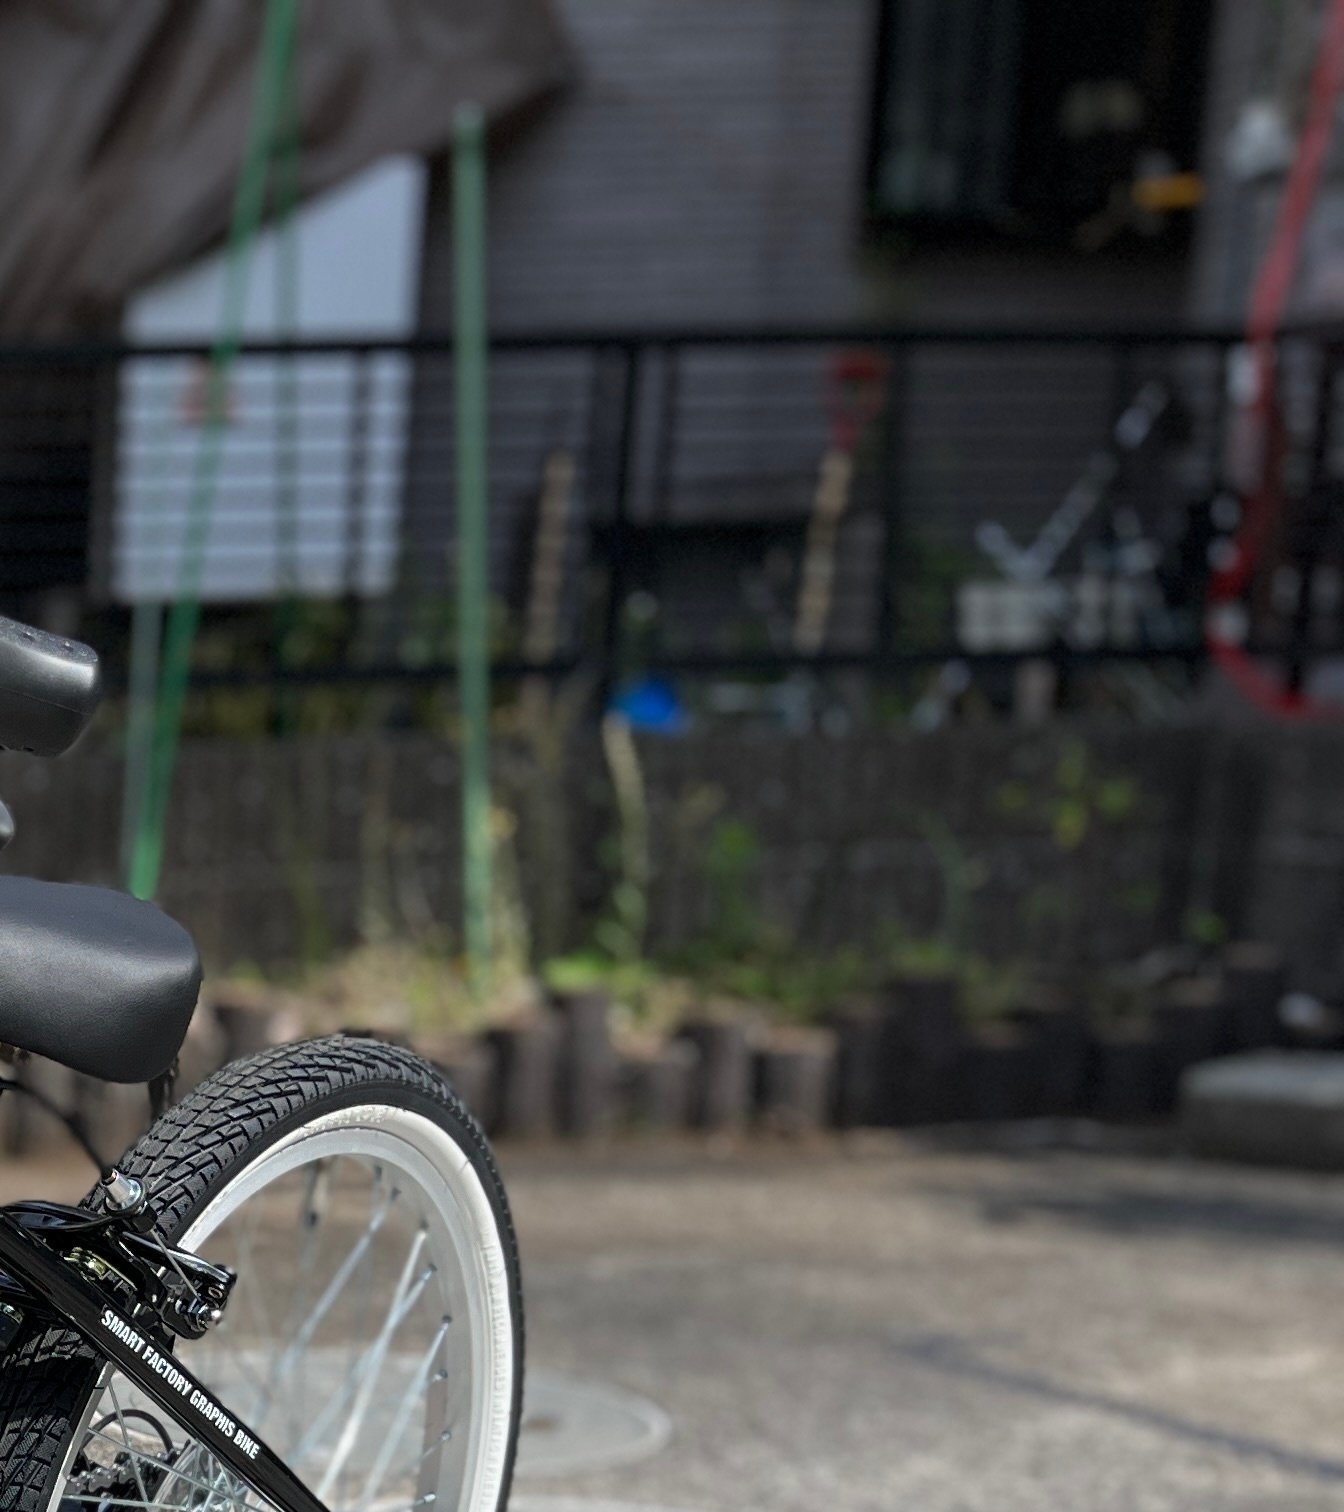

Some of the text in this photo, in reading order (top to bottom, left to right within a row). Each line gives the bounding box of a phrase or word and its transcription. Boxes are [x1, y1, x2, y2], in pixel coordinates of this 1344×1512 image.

[101, 1310, 261, 1460] SMART FACTORY GRAPHIS BIKE
